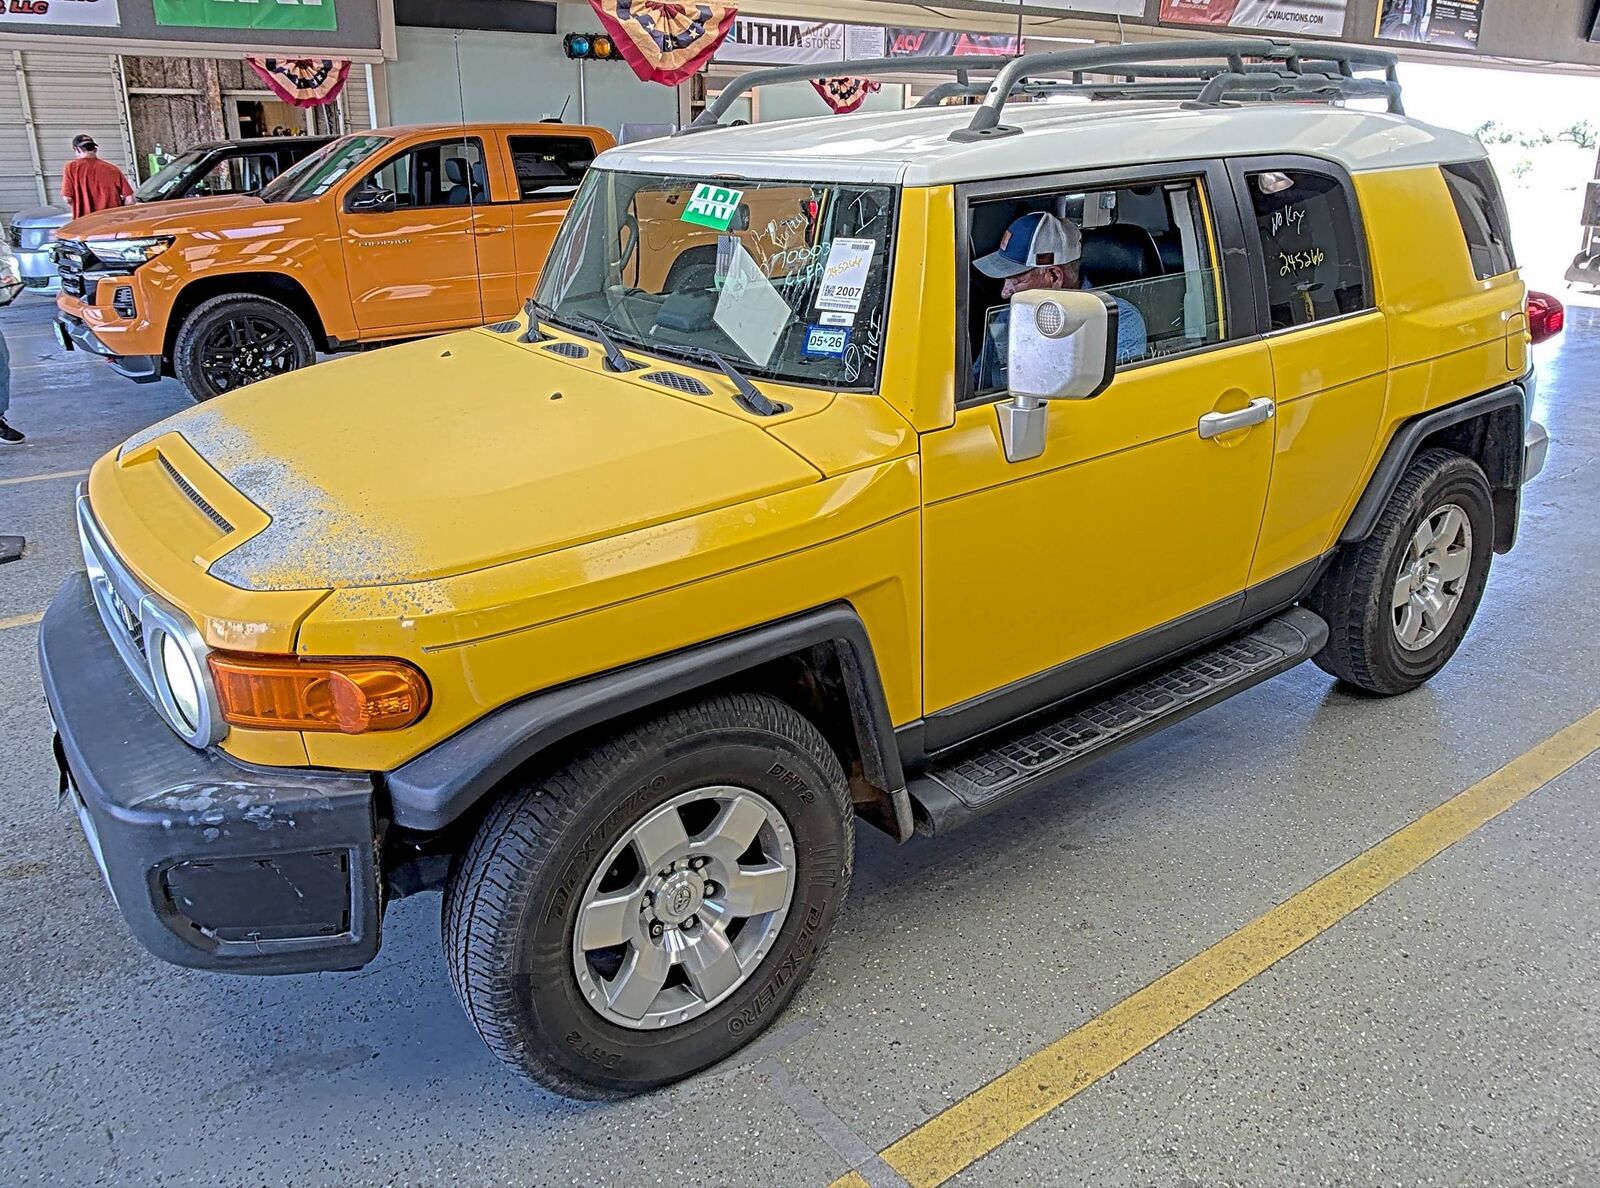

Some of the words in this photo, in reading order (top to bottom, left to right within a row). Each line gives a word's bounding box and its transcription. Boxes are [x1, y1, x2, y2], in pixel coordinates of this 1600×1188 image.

[9, 0, 49, 15] LLC
[736, 21, 802, 47] LITHIA
[806, 26, 831, 37] AUTO
[805, 37, 841, 50] STORES
[892, 32, 926, 52] ACV
[836, 287, 861, 297] 2007
[766, 761, 815, 806] DHT2
[727, 899, 827, 1038] DEXTERO
